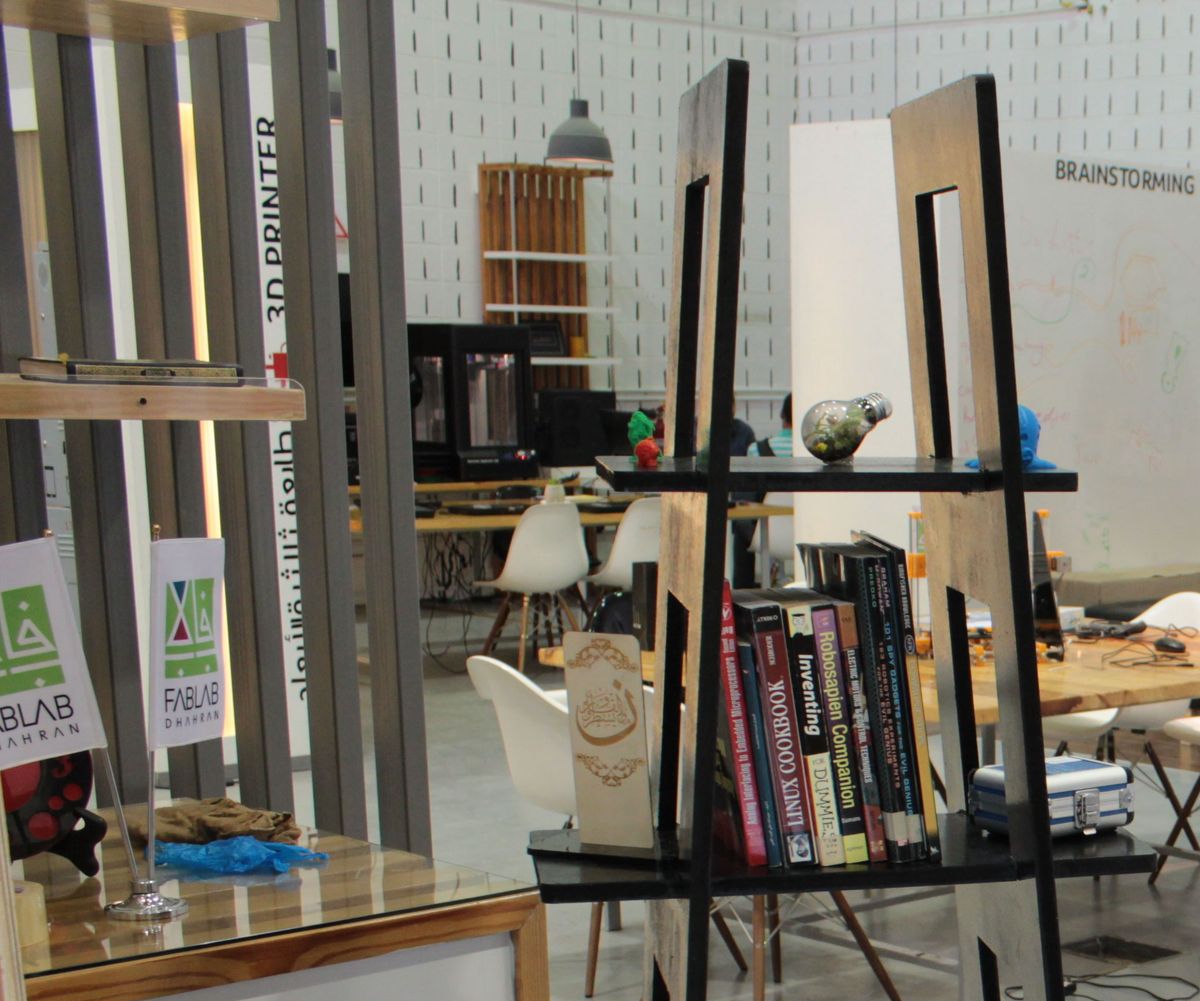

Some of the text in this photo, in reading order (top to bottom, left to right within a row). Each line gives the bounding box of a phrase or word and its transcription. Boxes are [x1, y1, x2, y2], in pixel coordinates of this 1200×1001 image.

[1055, 158, 1196, 197] BRAINSTORMING
[256, 116, 285, 323] 3D PRINTER
[164, 681, 219, 713] FABLAB
[724, 656, 744, 718] Microprocessors
[798, 654, 821, 736] Inventing
[886, 645, 896, 666] SPY
[900, 752, 909, 776] EVIL
[0, 723, 80, 750] AHRAN
[165, 710, 220, 729] DHAHRAN
[731, 719, 749, 753] Embedded
[767, 680, 796, 774] COOKBOOK
[819, 631, 843, 721] Robosapien
[831, 723, 857, 809] Companion
[847, 649, 859, 679] ELECTRIC
[860, 745, 873, 784] TECHNIQUES
[737, 762, 755, 801] Interfacing
[782, 777, 804, 827] LINUX
